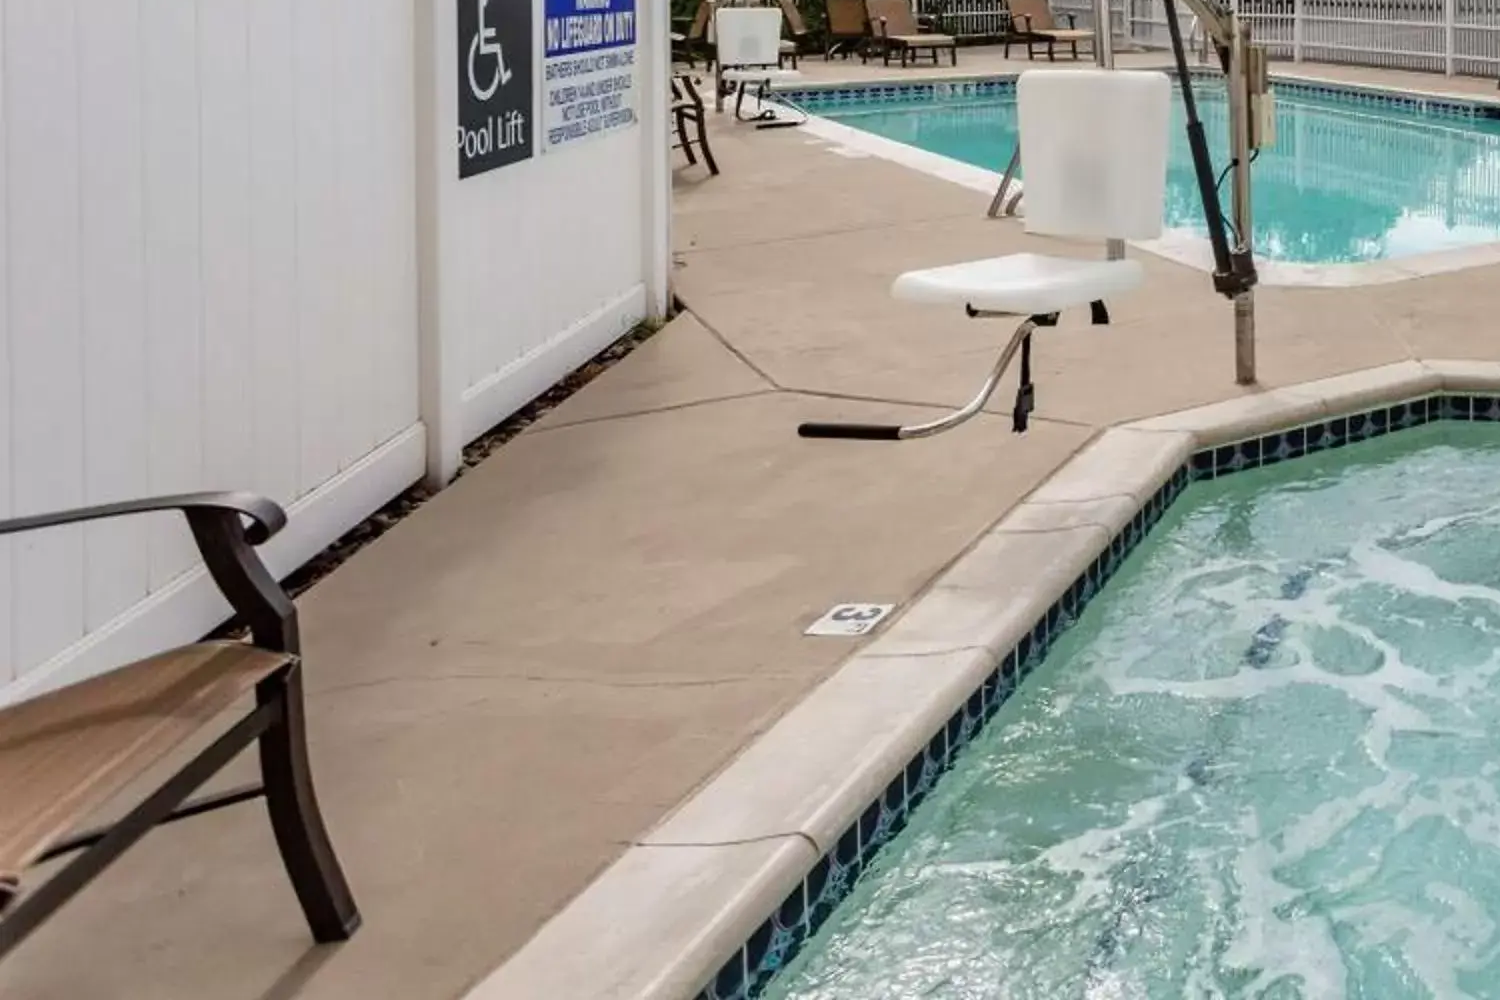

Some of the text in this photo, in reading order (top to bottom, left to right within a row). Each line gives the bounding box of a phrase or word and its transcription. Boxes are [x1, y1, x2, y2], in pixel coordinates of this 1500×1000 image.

[457, 114, 493, 159] Pool
[497, 110, 526, 150] Lift
[831, 606, 883, 621] 3
